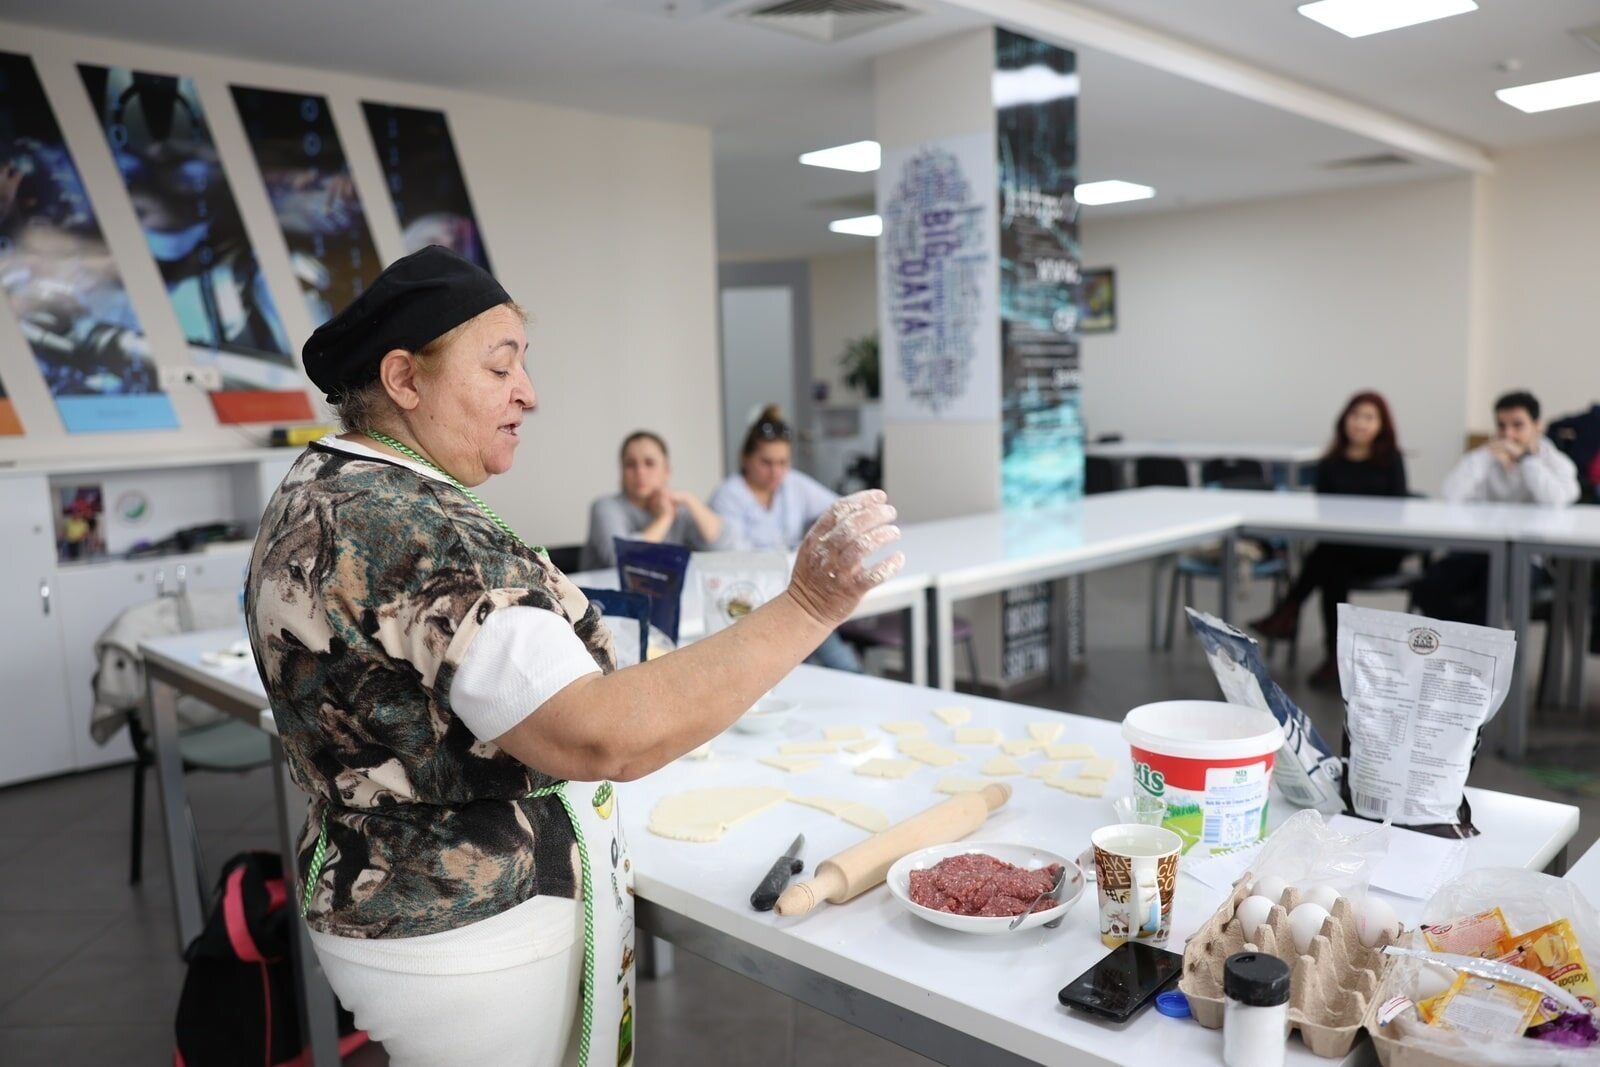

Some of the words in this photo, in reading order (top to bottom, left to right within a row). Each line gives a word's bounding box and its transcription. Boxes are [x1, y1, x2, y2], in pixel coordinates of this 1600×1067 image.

[924, 209, 961, 259] BIG
[901, 259, 932, 335] DATA
[1101, 856, 1131, 870] AKE
[1554, 972, 1589, 988] Kabar
